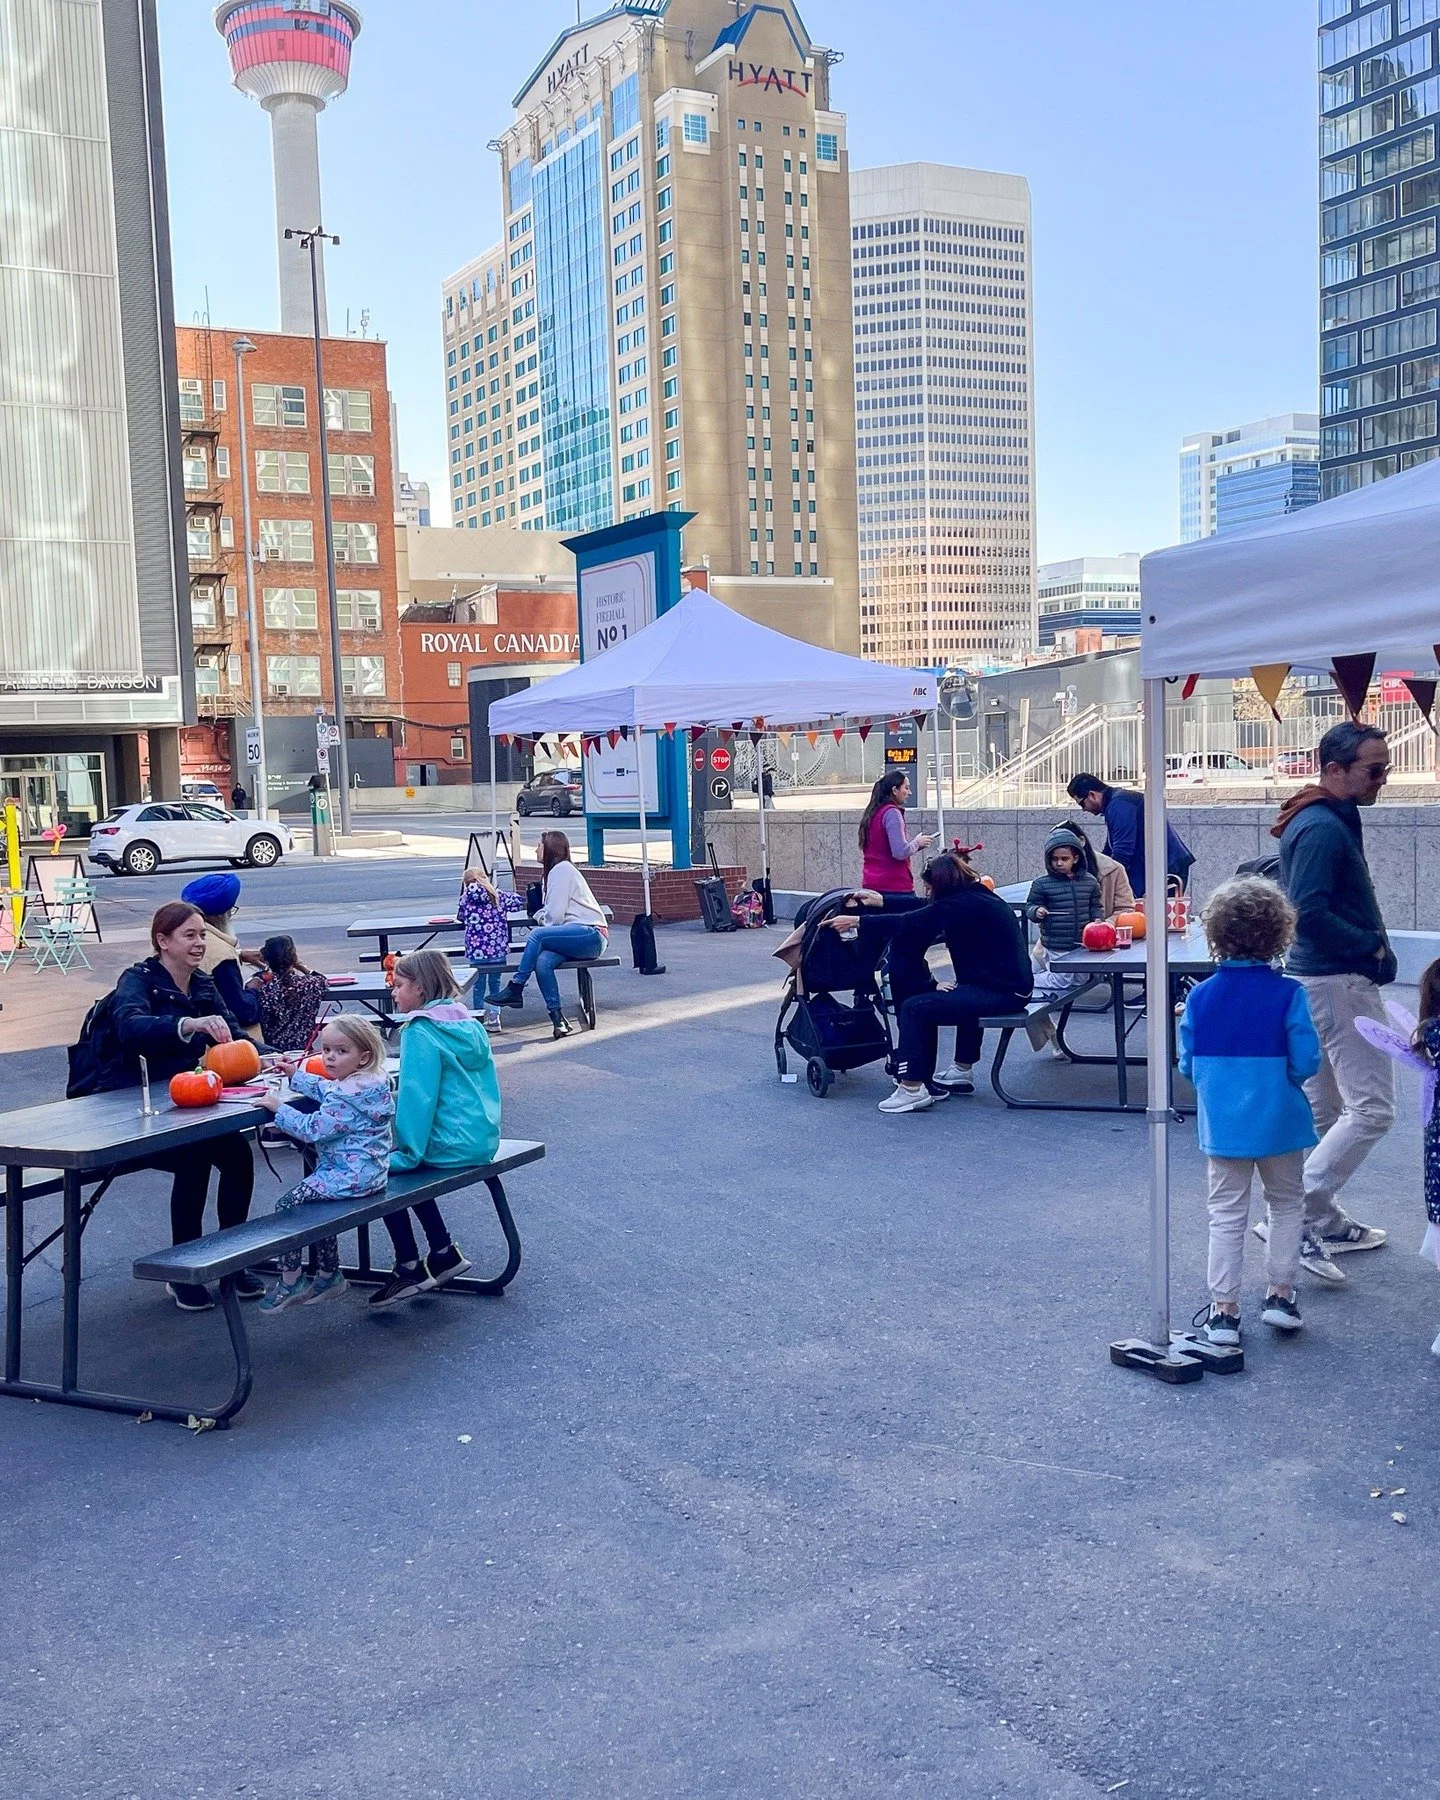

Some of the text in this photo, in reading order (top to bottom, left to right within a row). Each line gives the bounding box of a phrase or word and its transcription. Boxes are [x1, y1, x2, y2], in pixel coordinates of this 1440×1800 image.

[547, 43, 588, 94] HYATT
[728, 60, 812, 95] HYATT
[596, 591, 626, 608] HISTORIC
[596, 607, 626, 624] FIREHALL
[420, 633, 488, 653] ROYAL
[4, 675, 157, 690] ANDREW DAVISON
[913, 687, 927, 696] ABC
[248, 743, 260, 760] 50
[713, 756, 729, 764] STOP
